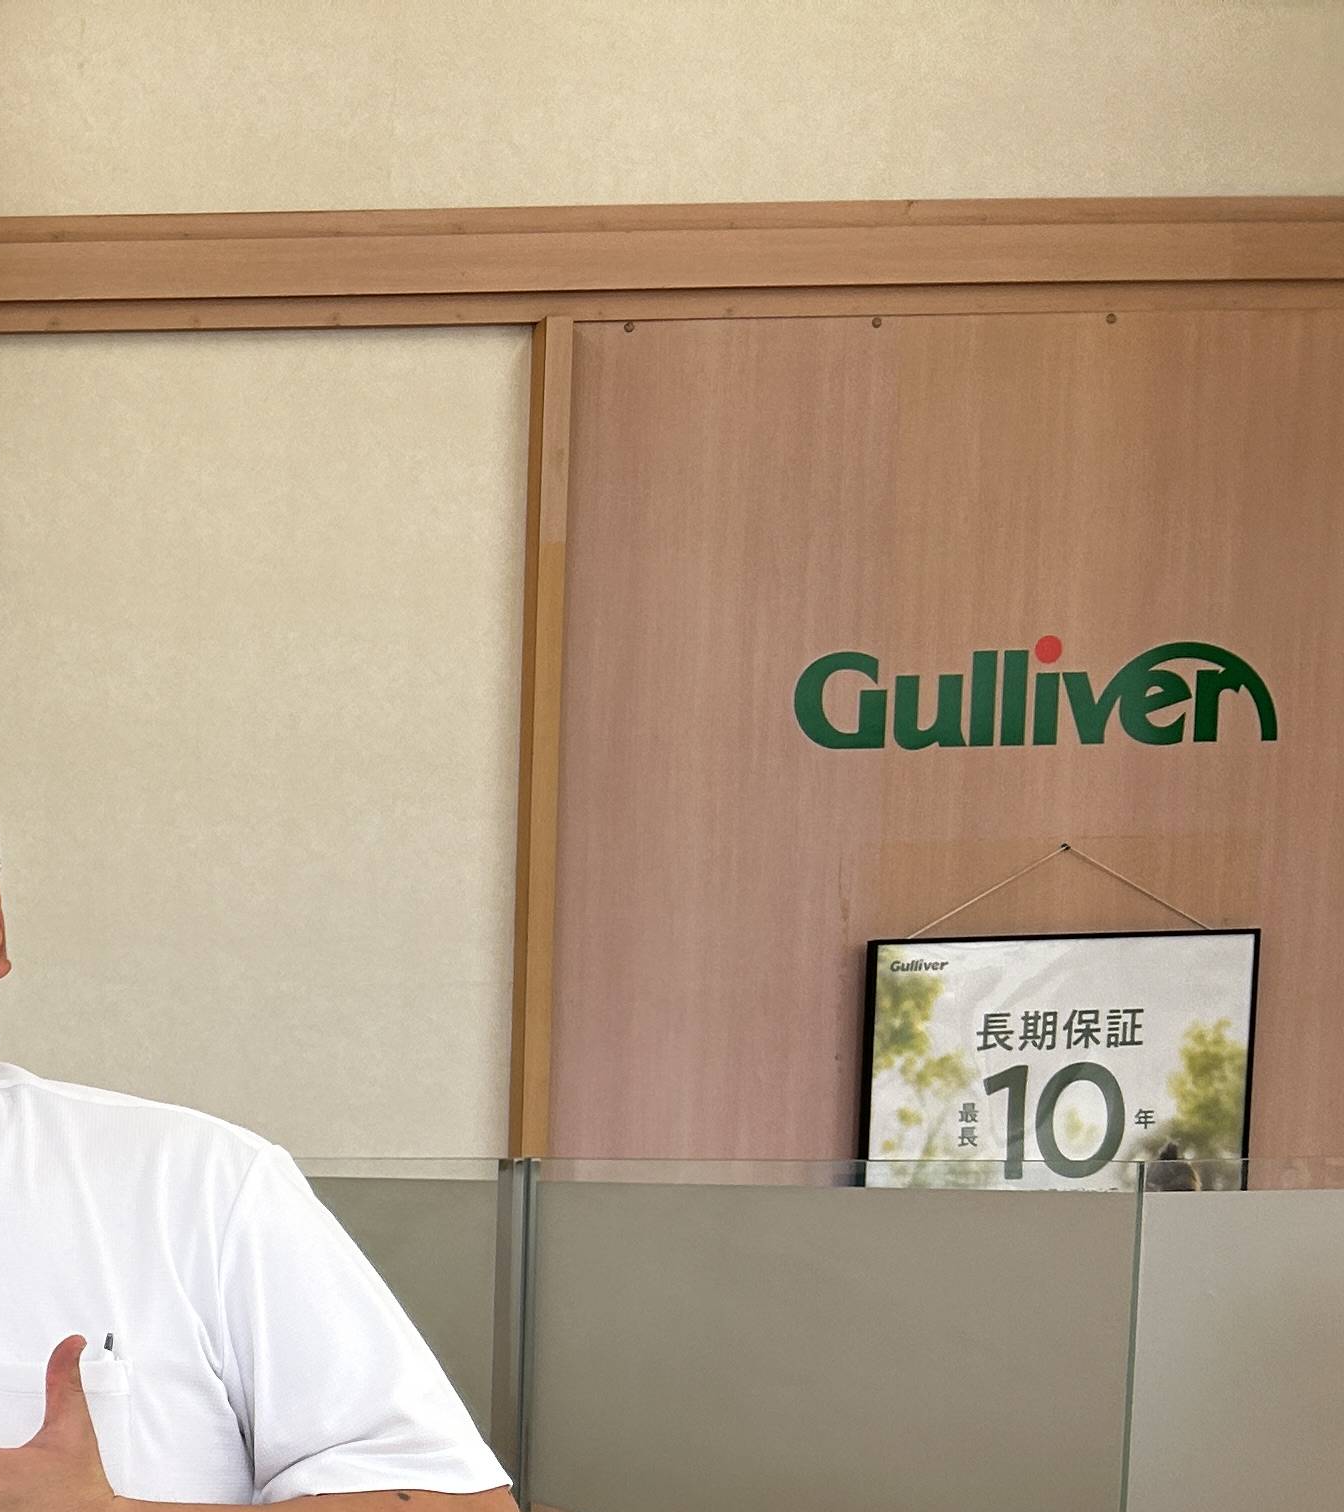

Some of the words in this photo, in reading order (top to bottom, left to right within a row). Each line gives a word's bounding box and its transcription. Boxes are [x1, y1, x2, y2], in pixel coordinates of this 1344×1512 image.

[794, 635, 1278, 750] Gulliver
[890, 958, 949, 973] Gulliver
[976, 1008, 1144, 1052] 長期保証
[958, 1102, 978, 1148] 最長
[984, 1061, 1126, 1180] 10
[1134, 1108, 1156, 1129] 年
